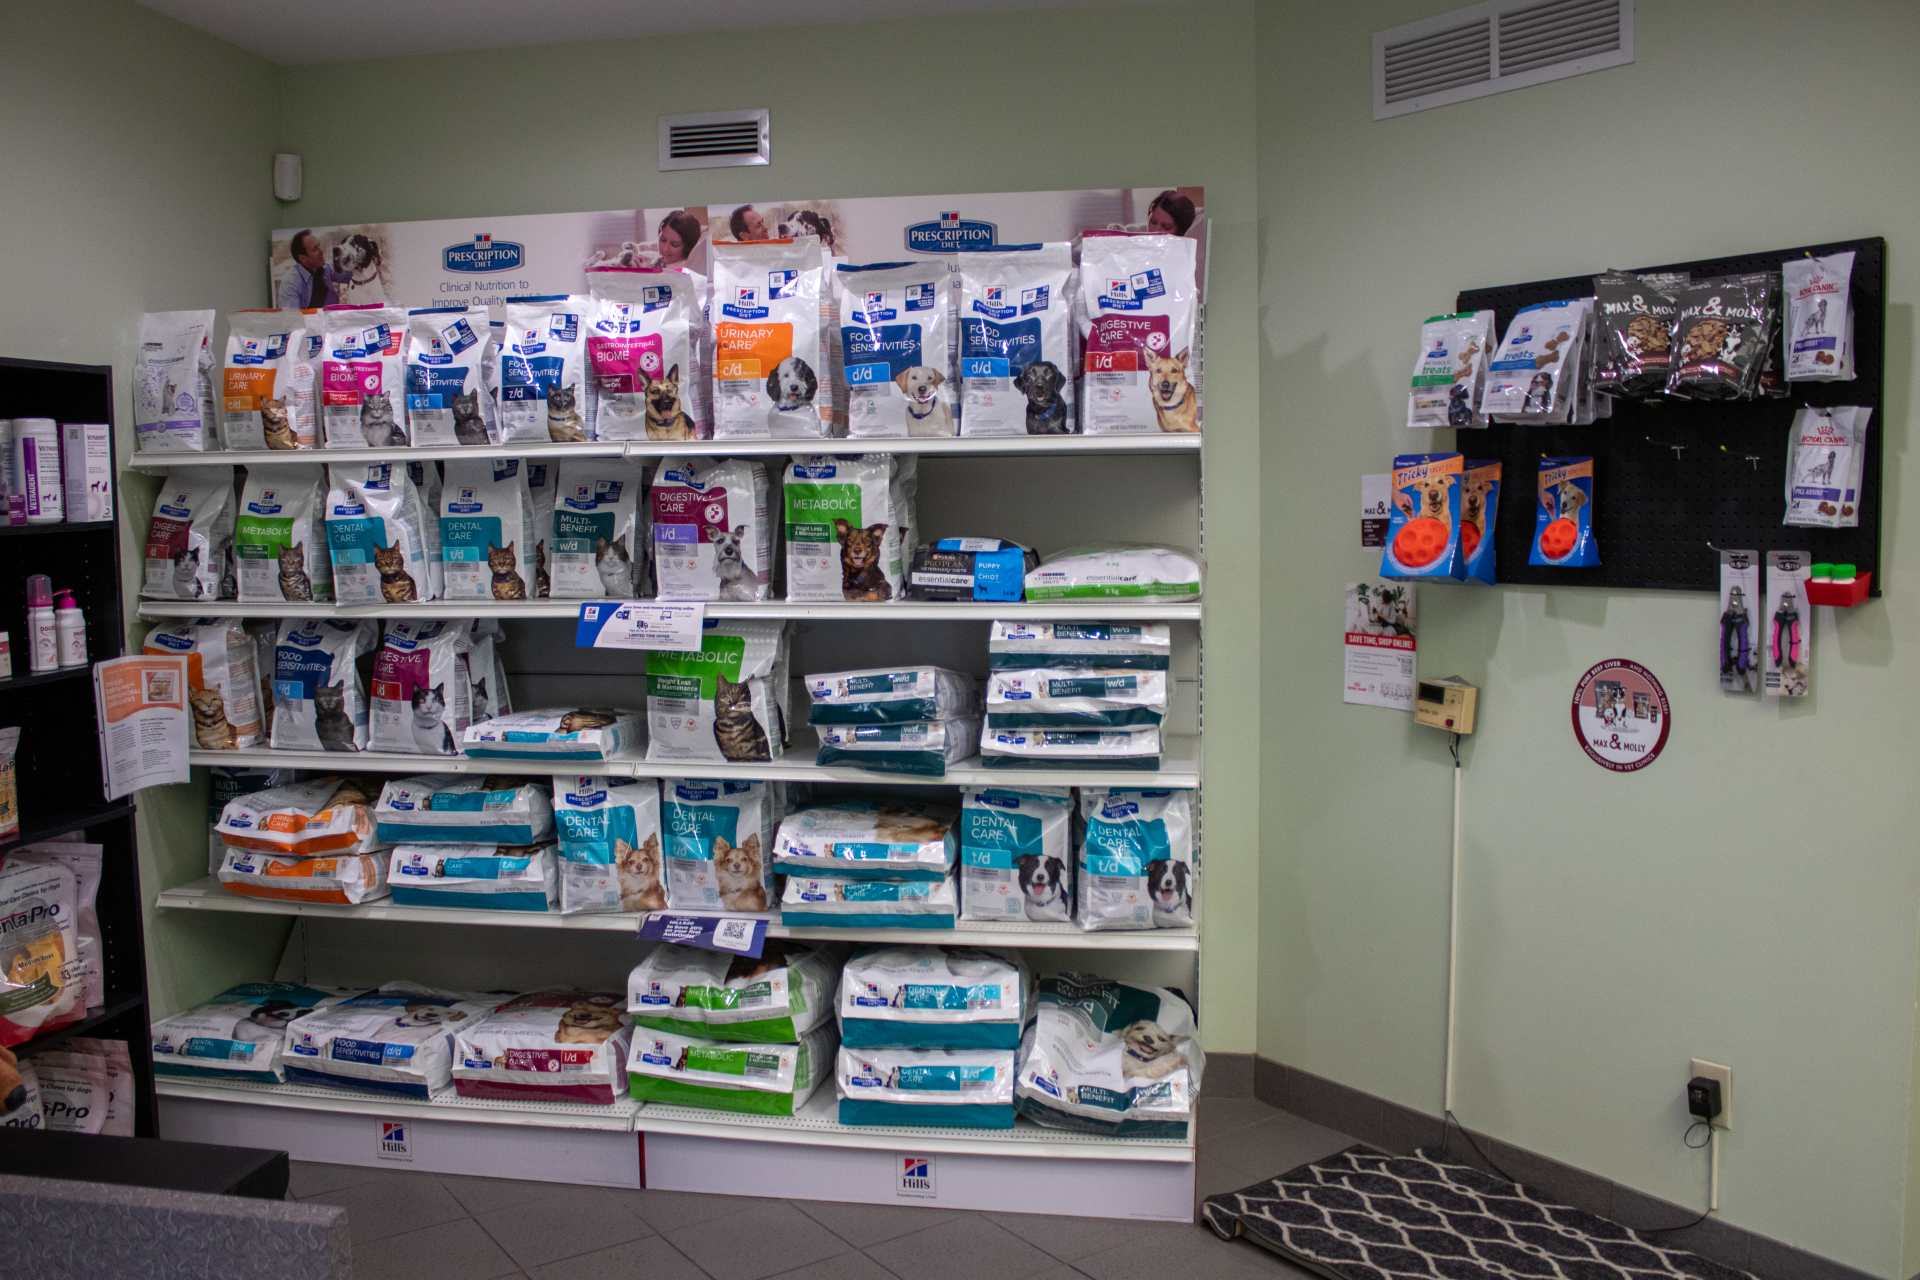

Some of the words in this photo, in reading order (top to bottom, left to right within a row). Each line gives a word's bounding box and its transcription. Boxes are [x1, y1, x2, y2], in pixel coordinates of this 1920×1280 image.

[911, 229, 990, 242] PRESCRIPTION
[448, 249, 519, 263] PRESCRIPTION
[440, 281, 472, 293] Clinical
[474, 280, 515, 291] Nutrition
[519, 279, 529, 289] to
[432, 298, 470, 310] Improve
[726, 306, 766, 314] PRESCRIPTION
[1604, 301, 1631, 315] MAX
[1632, 295, 1648, 313] &
[1652, 305, 1676, 315] MOL
[1681, 307, 1702, 320] MAX
[1703, 297, 1722, 315] &
[1725, 307, 1763, 319] MOLLY
[970, 325, 1000, 337] FOOD
[1100, 320, 1151, 332] DIGESTIVE
[720, 329, 774, 338] URINARY
[1100, 331, 1124, 344] CARE
[721, 340, 753, 350] CARE
[850, 340, 915, 353] SENSTIVITIES
[596, 350, 629, 362] BIOME
[1096, 355, 1113, 369] i/d
[1504, 352, 1534, 360] treats
[723, 363, 742, 376] c/d
[971, 361, 991, 374] d/d
[1422, 366, 1450, 375] treats
[852, 368, 872, 381] d/d
[508, 389, 523, 399] z/d
[1397, 468, 1428, 485] Tricky
[659, 503, 685, 513] CARE
[793, 499, 857, 510] METABOLIC
[1376, 501, 1386, 515] &
[560, 514, 591, 524] MULTI-
[242, 526, 290, 535] METABOLIC
[334, 523, 365, 533] DENTAL
[448, 522, 482, 531] DENTAL
[560, 523, 597, 533] BENEFIT
[334, 532, 356, 543] CARE
[448, 531, 472, 541] CARE
[661, 528, 675, 541] i/d
[559, 541, 578, 551] w/d
[918, 575, 968, 585] essentialcare
[1349, 635, 1363, 643] SAVE
[1378, 637, 1392, 645] SHOP
[1393, 639, 1413, 649] ONLINE!
[278, 651, 302, 662] FOOD
[657, 650, 737, 664] METABOLIC
[1582, 674, 1591, 687] PURE
[1592, 665, 1603, 675] BEEF
[1630, 665, 1642, 673] AND
[1107, 679, 1125, 687] w/d
[1052, 687, 1082, 695] BENEFIT
[1593, 739, 1607, 748] MAX
[1609, 733, 1622, 750] &
[1623, 743, 1646, 752] MOLLY
[1584, 745, 1615, 768] EXCLUSIVELY
[1624, 762, 1634, 770] VET
[1635, 753, 1655, 767] CLINICS
[568, 793, 605, 801] PRESCRIPTION
[566, 816, 610, 826] DENTAL
[673, 810, 715, 822] DENTAL
[672, 821, 701, 833] CARE
[972, 816, 1017, 830] DENTAL
[568, 827, 599, 838] CARE
[971, 828, 1003, 841] CARE
[1099, 825, 1142, 837] DENTAL
[1098, 837, 1130, 848] CARE
[972, 852, 991, 864] t/d
[1099, 860, 1119, 873] t/d
[336, 1039, 357, 1047] FOOD
[336, 1047, 380, 1059] SENSITIVITIES
[386, 1048, 401, 1056] d/d
[564, 1053, 577, 1062] i/d
[1081, 1092, 1115, 1104] BENEFIT
[383, 1142, 407, 1152] Hill's
[903, 1178, 930, 1190] Hill's
